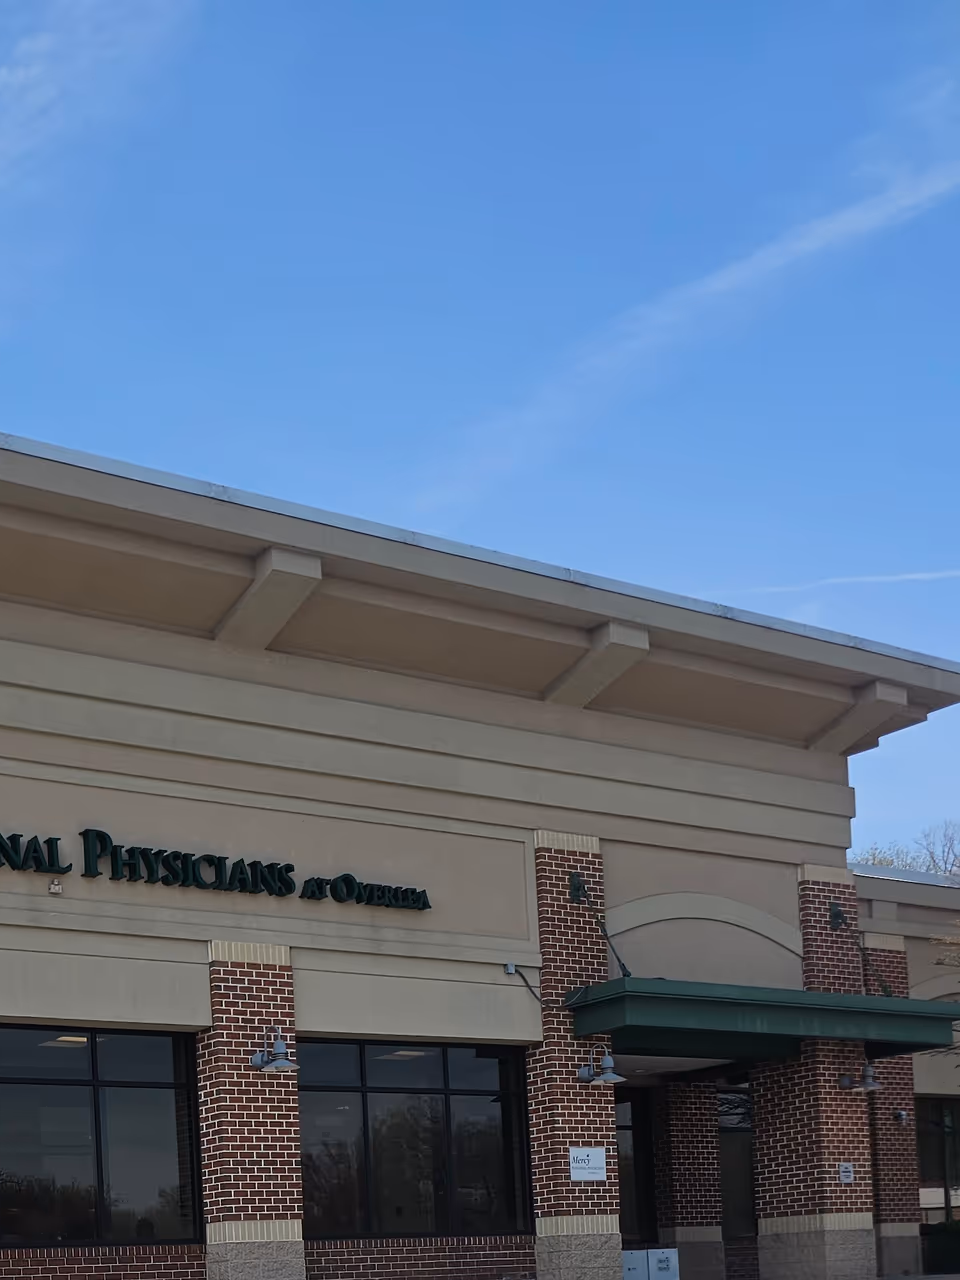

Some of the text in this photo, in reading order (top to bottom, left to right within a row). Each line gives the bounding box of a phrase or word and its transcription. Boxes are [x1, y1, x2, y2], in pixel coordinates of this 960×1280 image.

[79, 828, 295, 897] PHYSICIANS
[299, 877, 331, 900] AT
[330, 873, 432, 910] OVERLEA
[572, 1155, 591, 1166] Mercy
